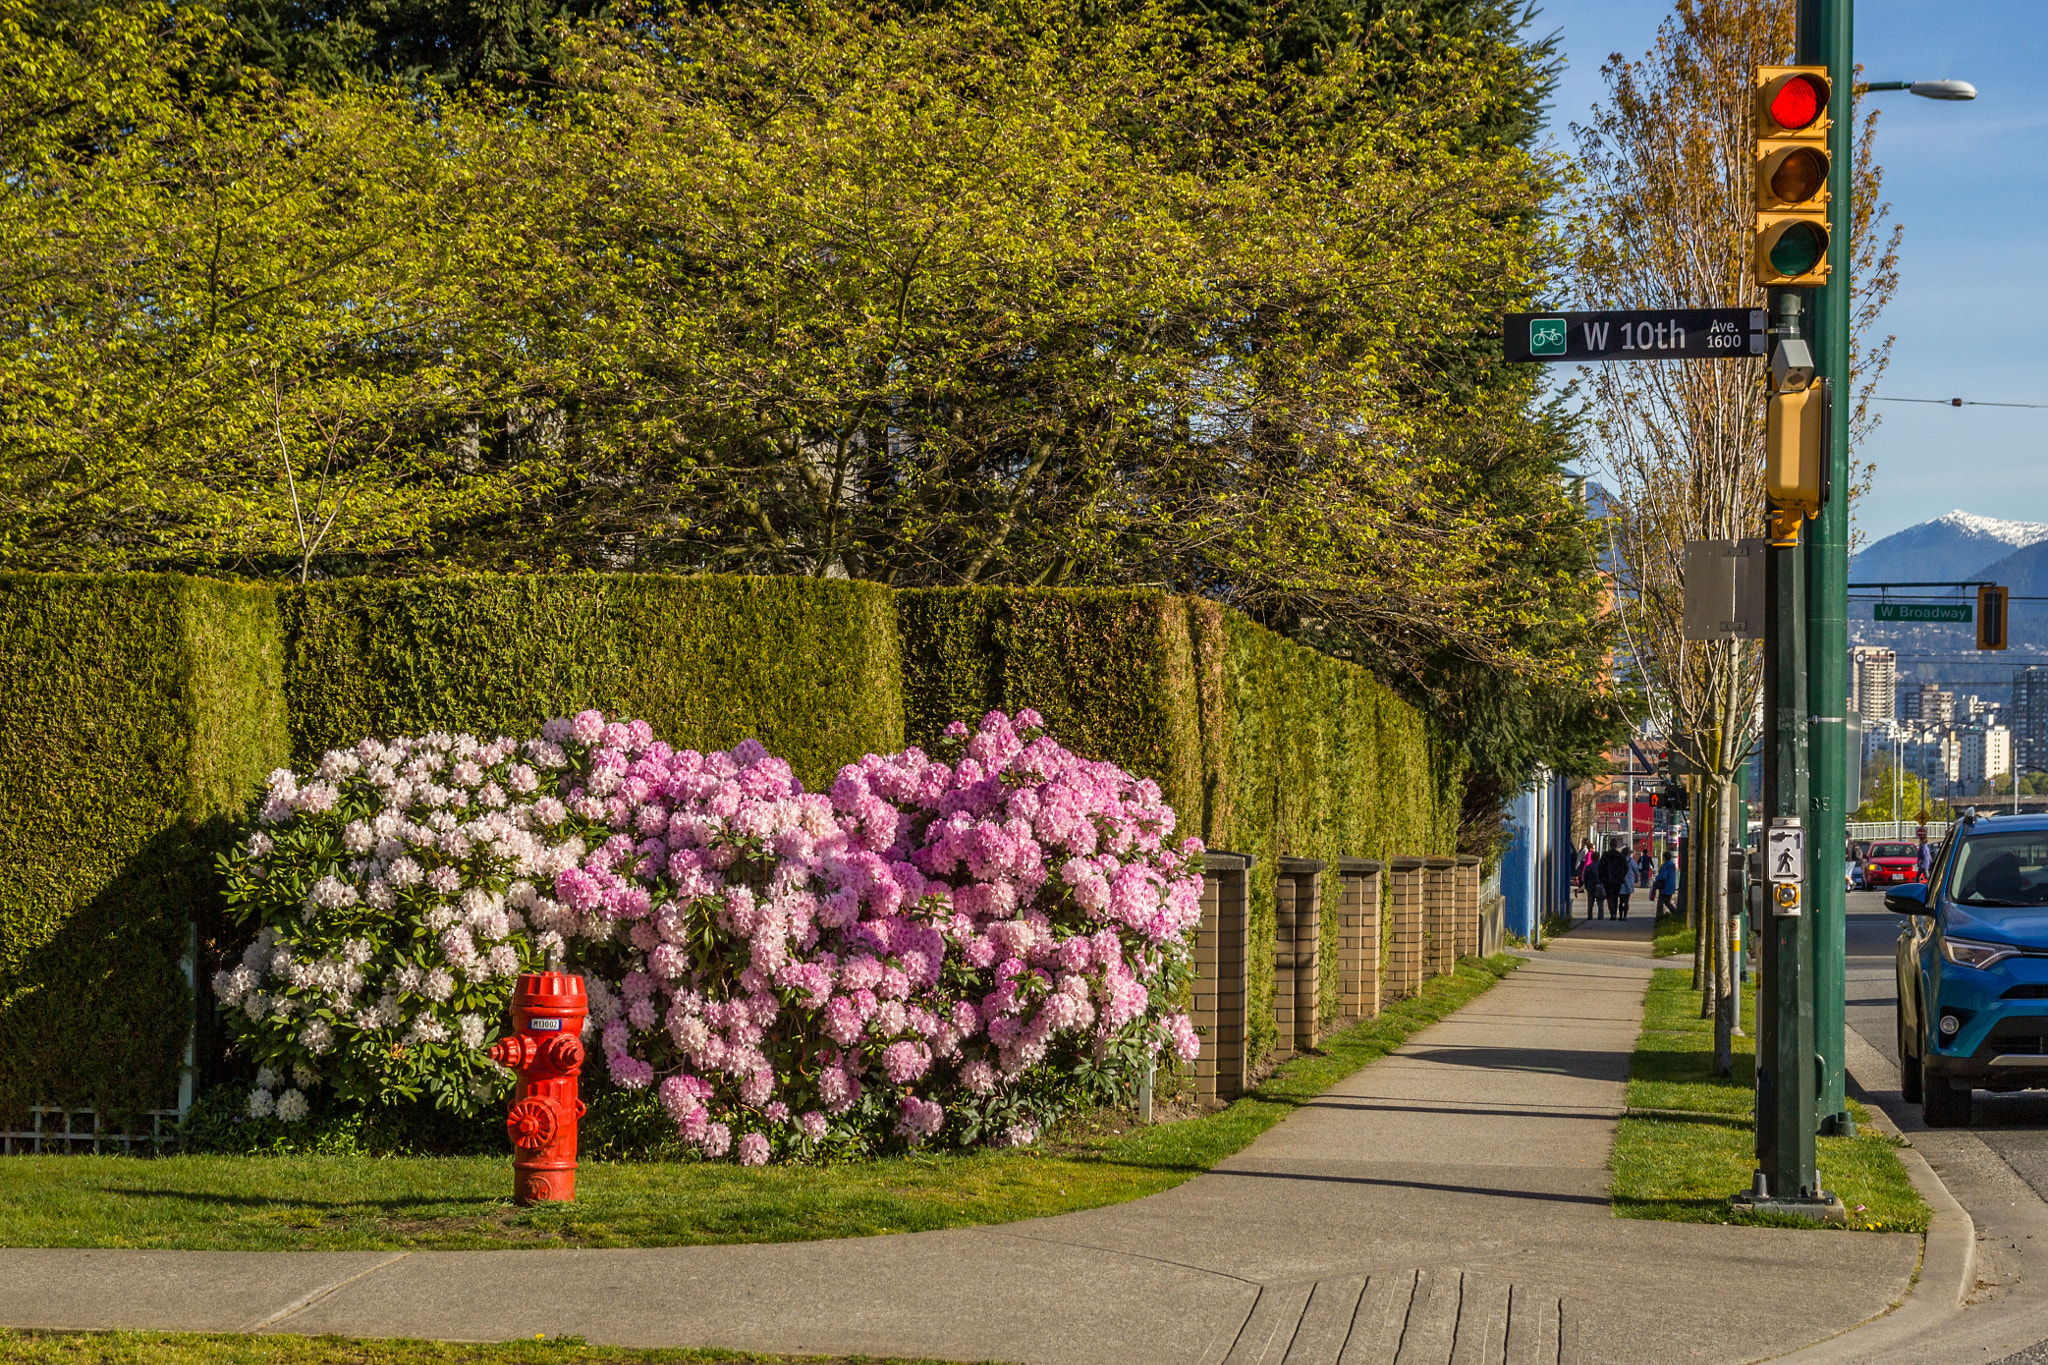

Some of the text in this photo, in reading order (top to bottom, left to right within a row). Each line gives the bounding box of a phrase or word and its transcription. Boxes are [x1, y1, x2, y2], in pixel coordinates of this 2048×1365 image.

[1710, 319, 1739, 333] Ave.
[1583, 319, 1686, 351] W 10th
[1707, 335, 1742, 349] 1600
[1880, 606, 1967, 620] W Broadway
